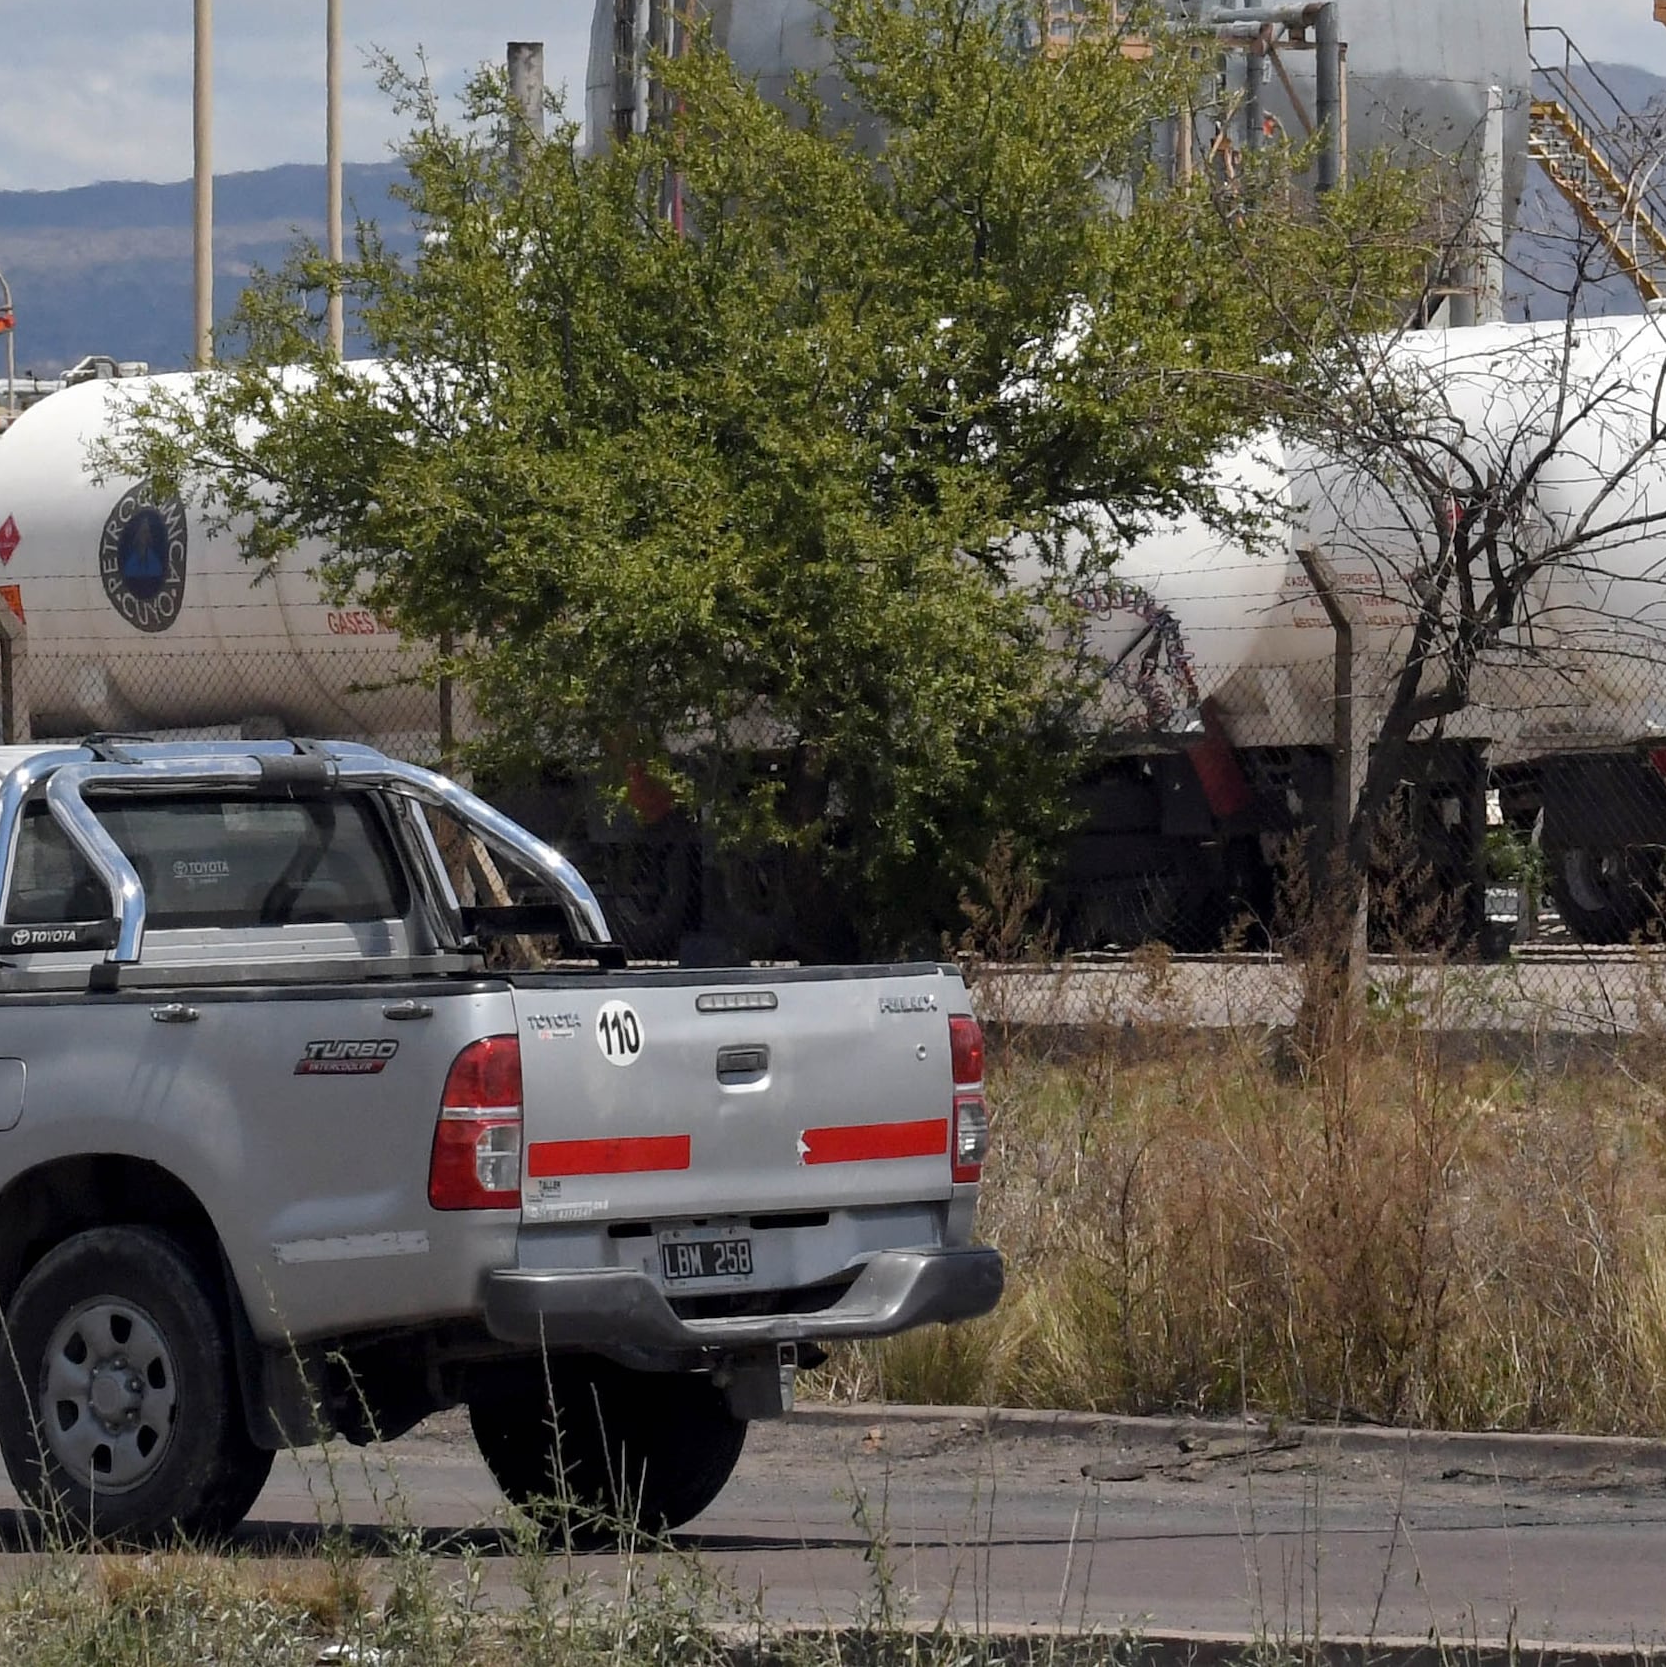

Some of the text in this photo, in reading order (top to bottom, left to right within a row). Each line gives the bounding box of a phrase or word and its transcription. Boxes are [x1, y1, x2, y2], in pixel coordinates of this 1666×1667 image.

[103, 486, 184, 594] PETROQMICA
[122, 591, 175, 626] CUYO
[188, 860, 230, 874] TOYOTA
[878, 995, 938, 1014] HILUX
[599, 1009, 640, 1055] 110
[306, 1041, 399, 1059] TURBO
[664, 1240, 751, 1278] LBM 258
